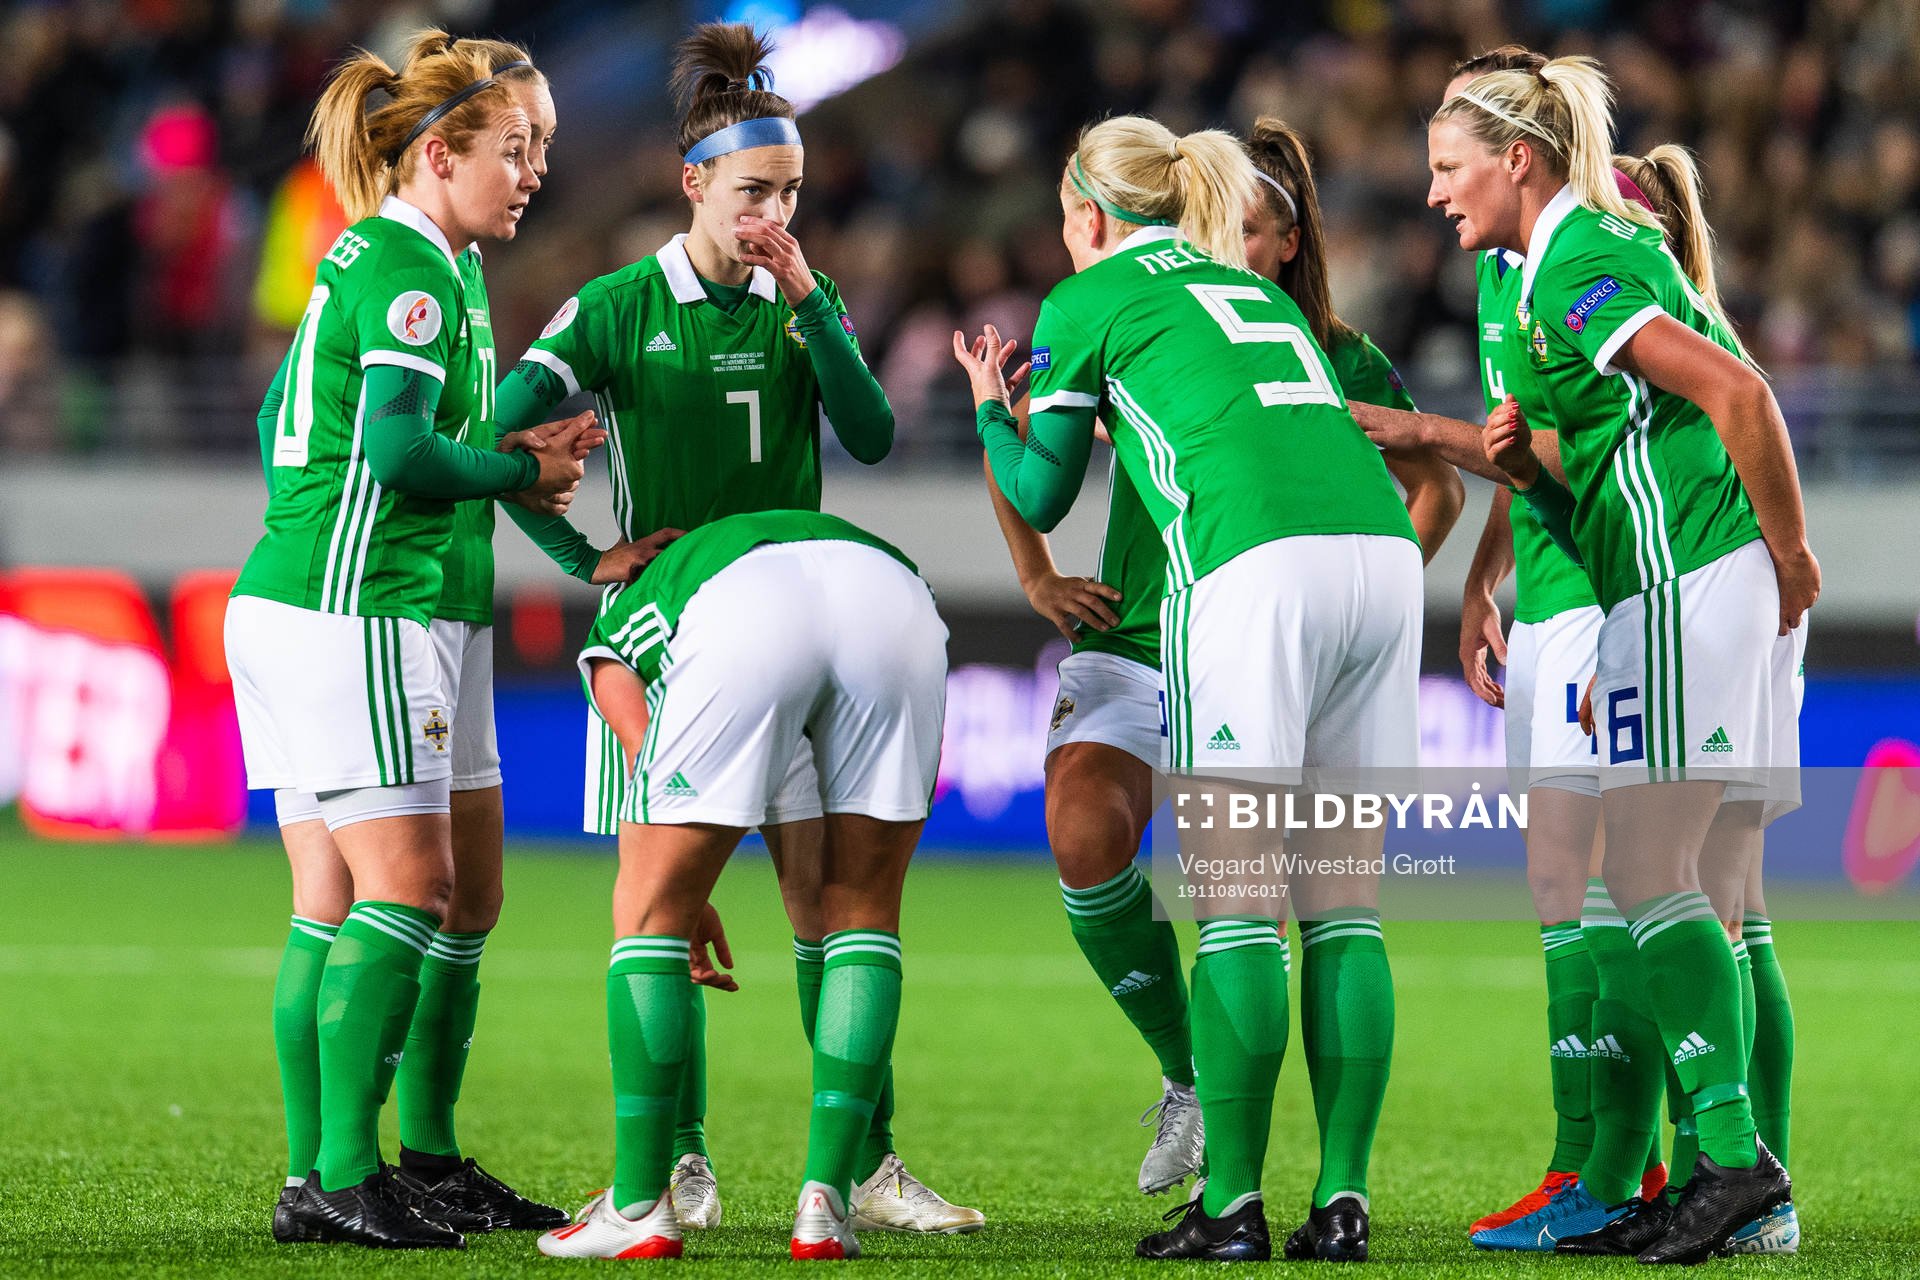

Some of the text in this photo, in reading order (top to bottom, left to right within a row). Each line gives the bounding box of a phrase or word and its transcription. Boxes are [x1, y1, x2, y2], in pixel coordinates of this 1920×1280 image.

[324, 229, 371, 269] ESS
[1575, 279, 1617, 317] RESPECT
[645, 343, 677, 352] adidas
[1184, 283, 1343, 409] 5
[726, 390, 762, 463] 7
[1608, 686, 1645, 766] 6
[1206, 741, 1241, 750] adidas
[1701, 742, 1734, 752] adidas
[1111, 974, 1161, 996] adidas
[1673, 1043, 1716, 1065] adidas
